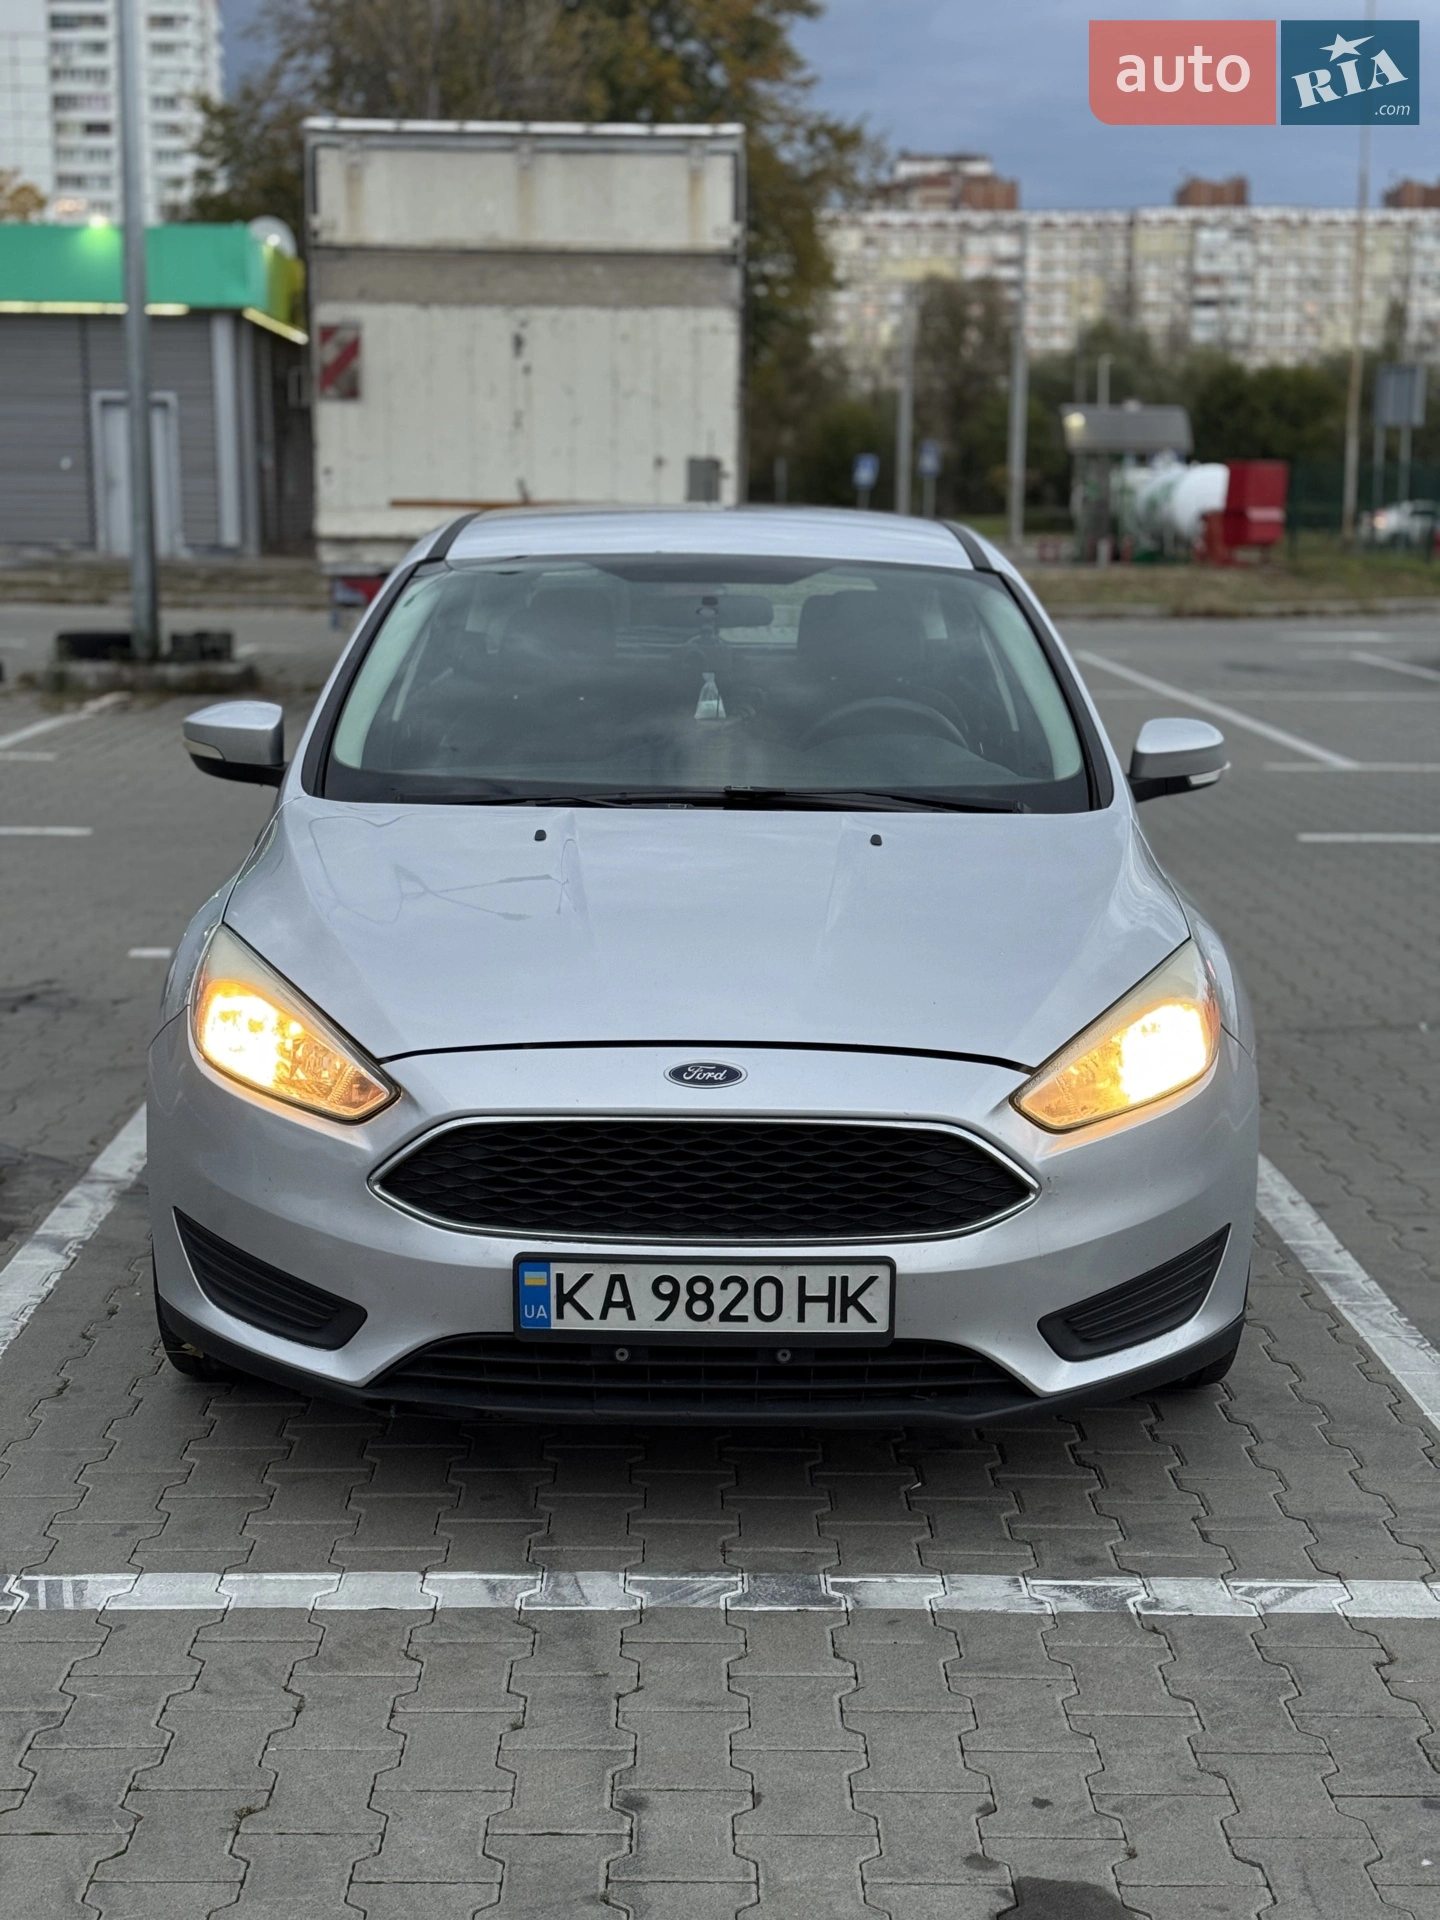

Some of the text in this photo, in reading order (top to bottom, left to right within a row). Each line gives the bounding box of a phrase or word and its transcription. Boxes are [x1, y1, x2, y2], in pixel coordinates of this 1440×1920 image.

[683, 1065, 727, 1080] Ford
[555, 1272, 879, 1324] KA 9820 HK
[524, 1304, 548, 1320] UA
